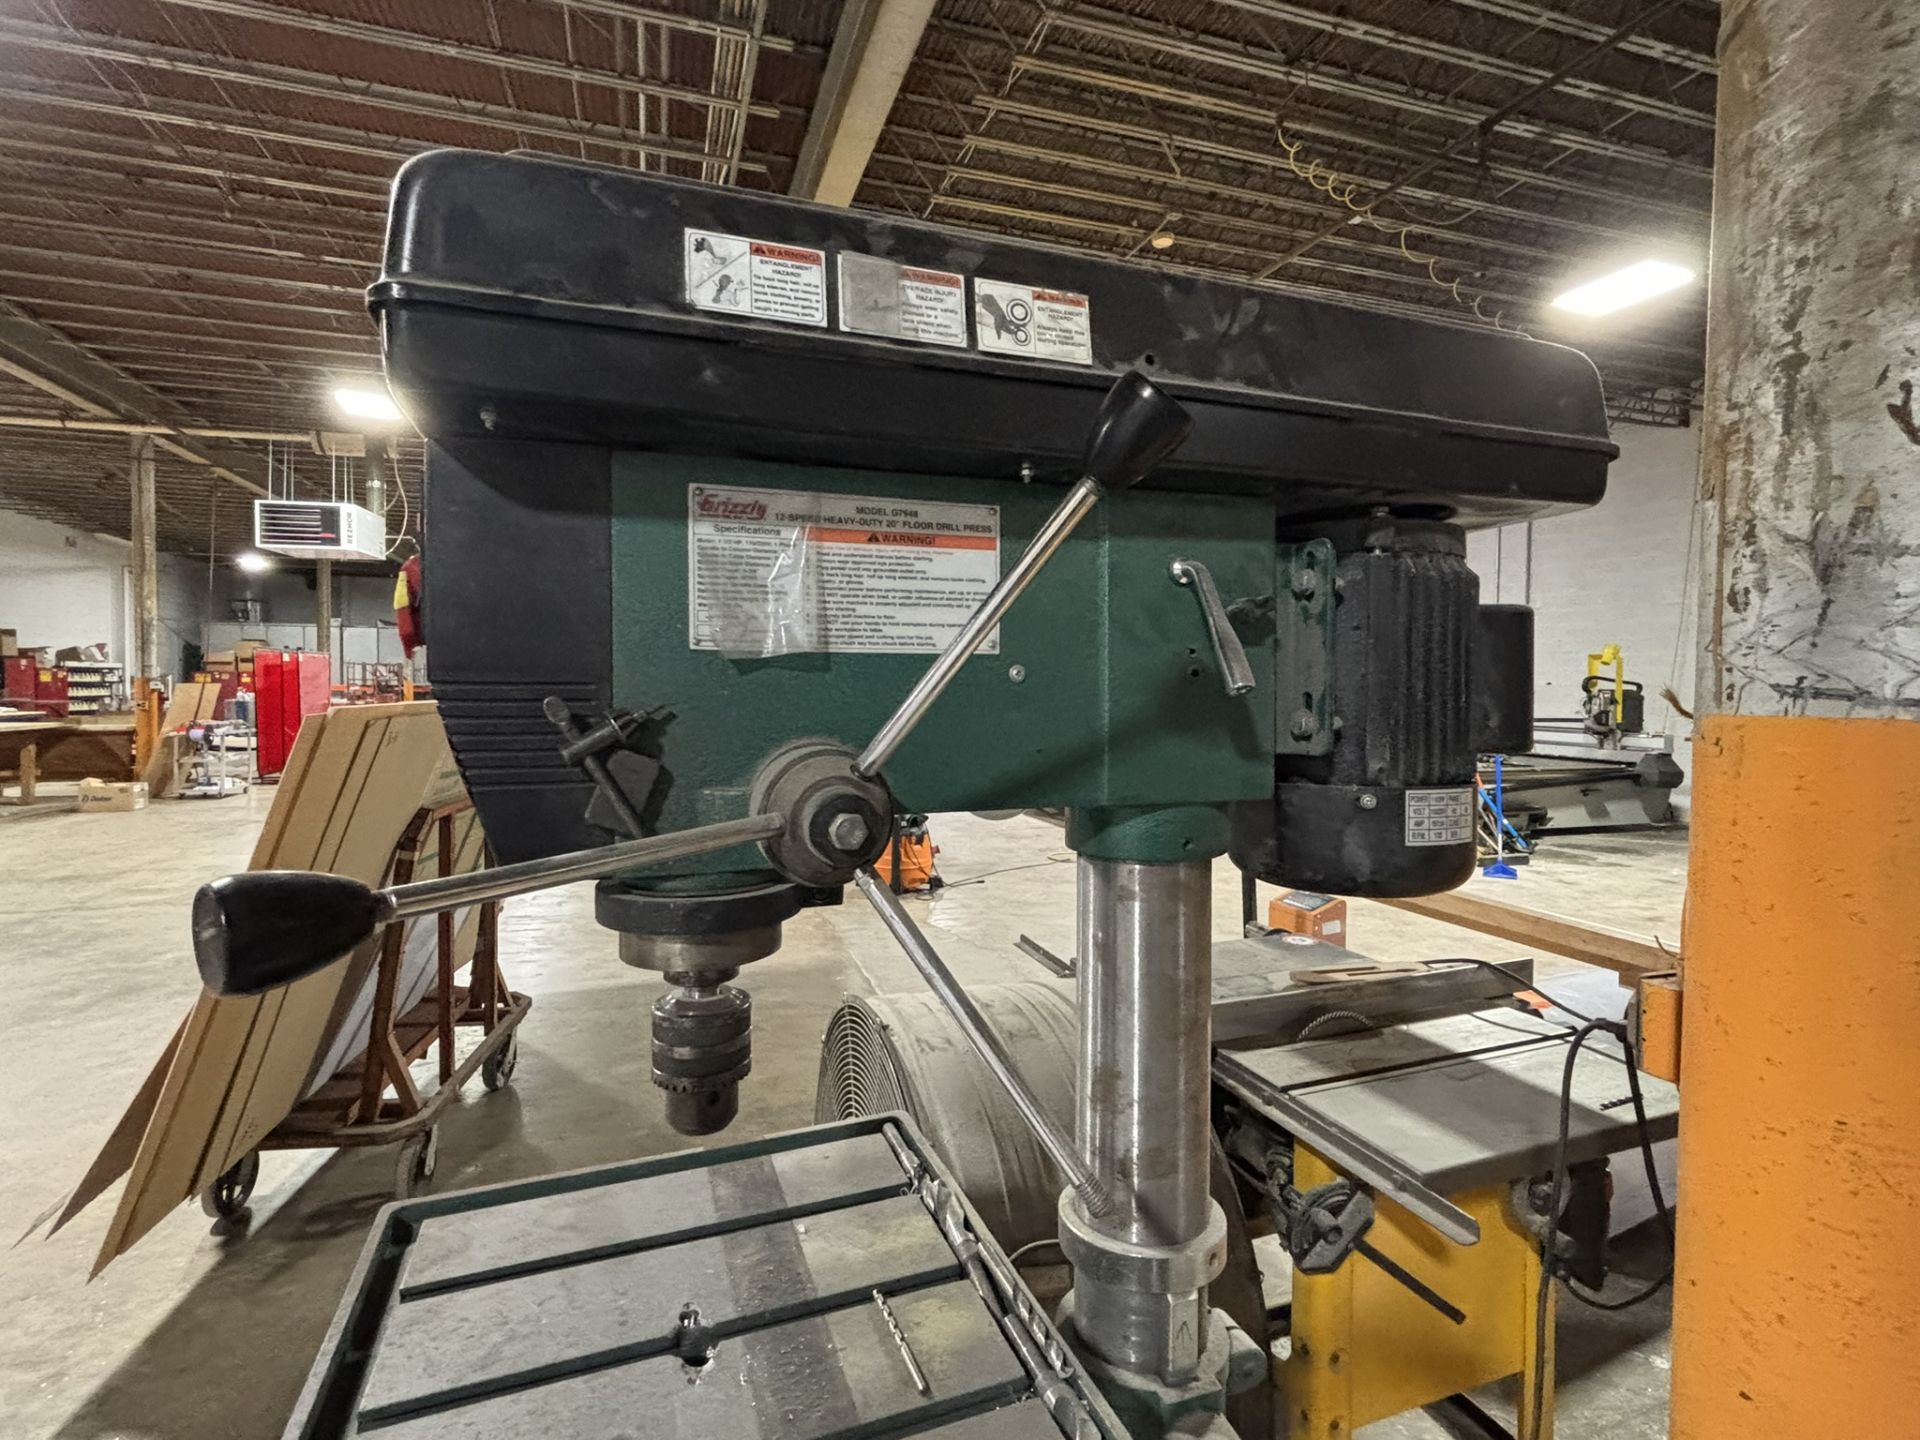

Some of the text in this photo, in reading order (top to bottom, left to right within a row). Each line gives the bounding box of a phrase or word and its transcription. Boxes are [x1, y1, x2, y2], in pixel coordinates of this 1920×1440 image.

[760, 259, 812, 272] ENTANGLEMENT
[697, 494, 767, 520] Grizzly
[856, 506, 888, 517] MODEL
[775, 512, 821, 523] 12-SPEED
[823, 513, 882, 529] HEAVY-DUTY
[902, 521, 933, 531] FLOOR
[935, 523, 960, 533] DRILL
[963, 524, 993, 534] PRESS
[713, 523, 781, 537] Specifications
[881, 534, 936, 546] WARNING!
